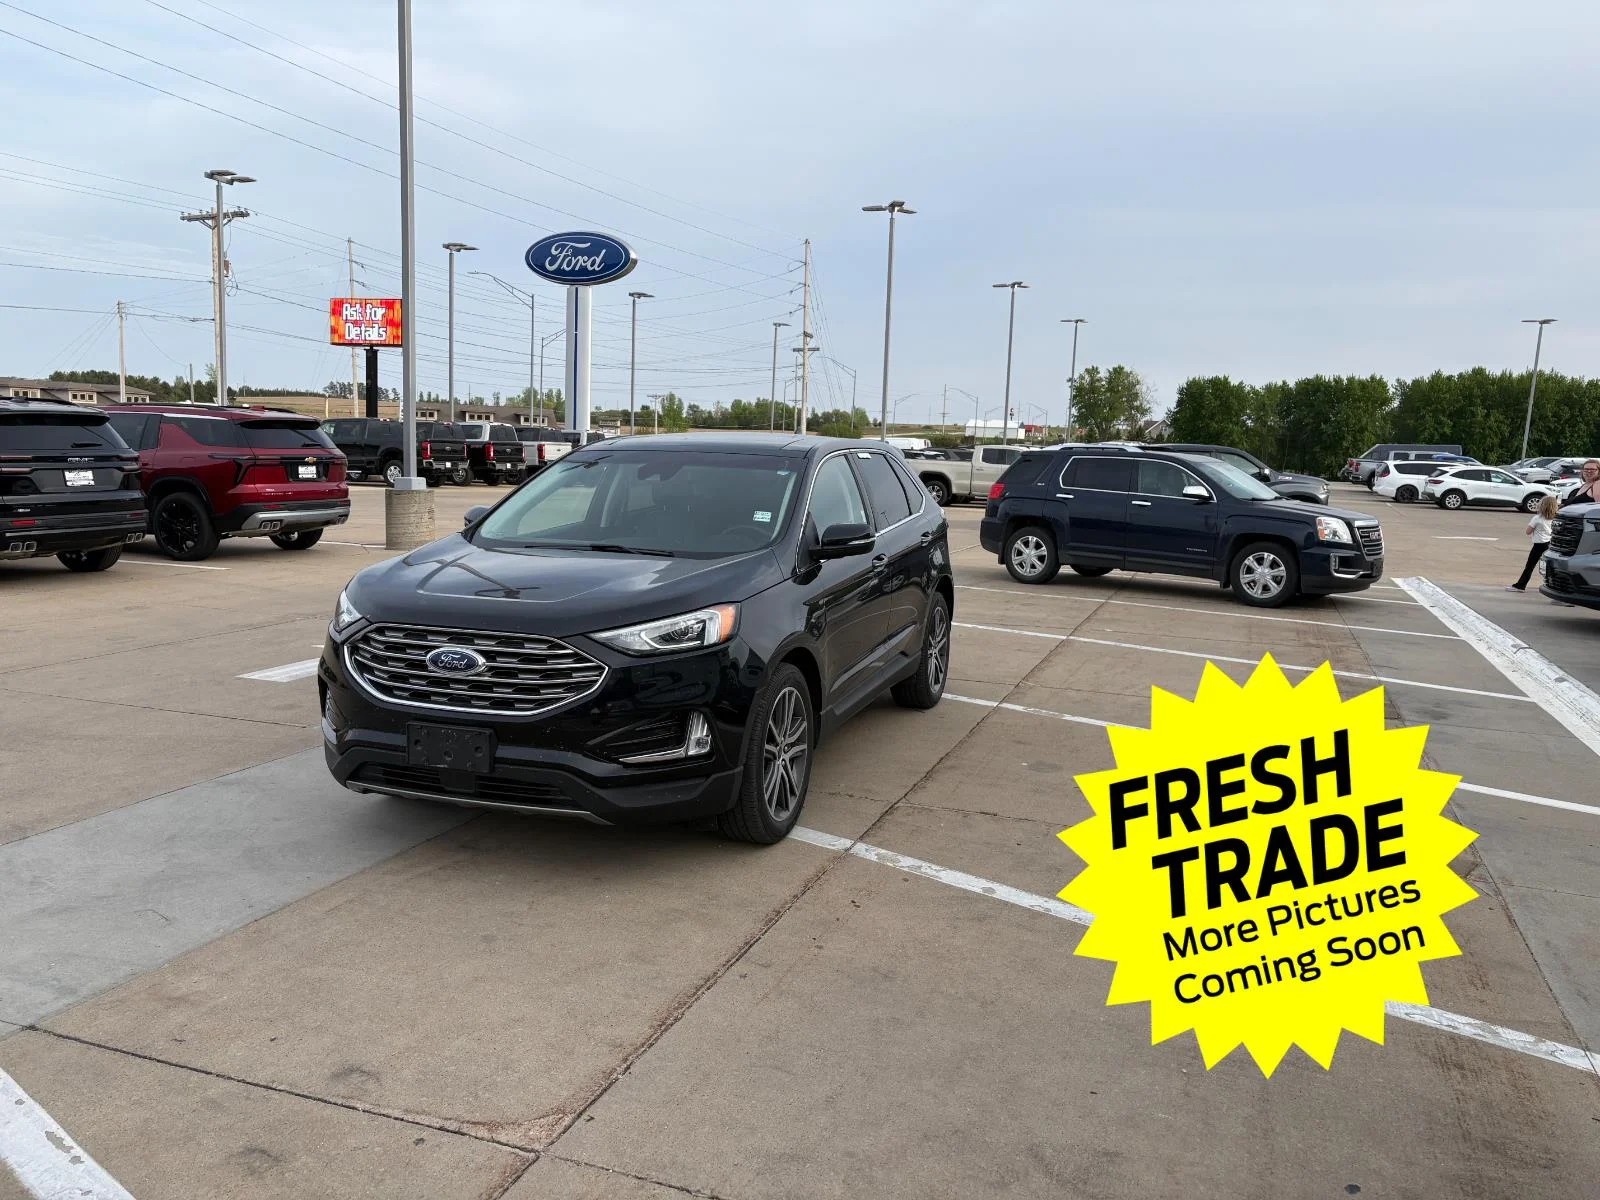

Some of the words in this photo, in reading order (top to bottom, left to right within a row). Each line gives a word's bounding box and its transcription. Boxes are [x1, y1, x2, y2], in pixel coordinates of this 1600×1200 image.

[544, 241, 607, 271] Ford
[342, 303, 363, 321] Ask
[365, 303, 386, 321] for
[345, 322, 387, 341] Details
[437, 653, 468, 669] Ford
